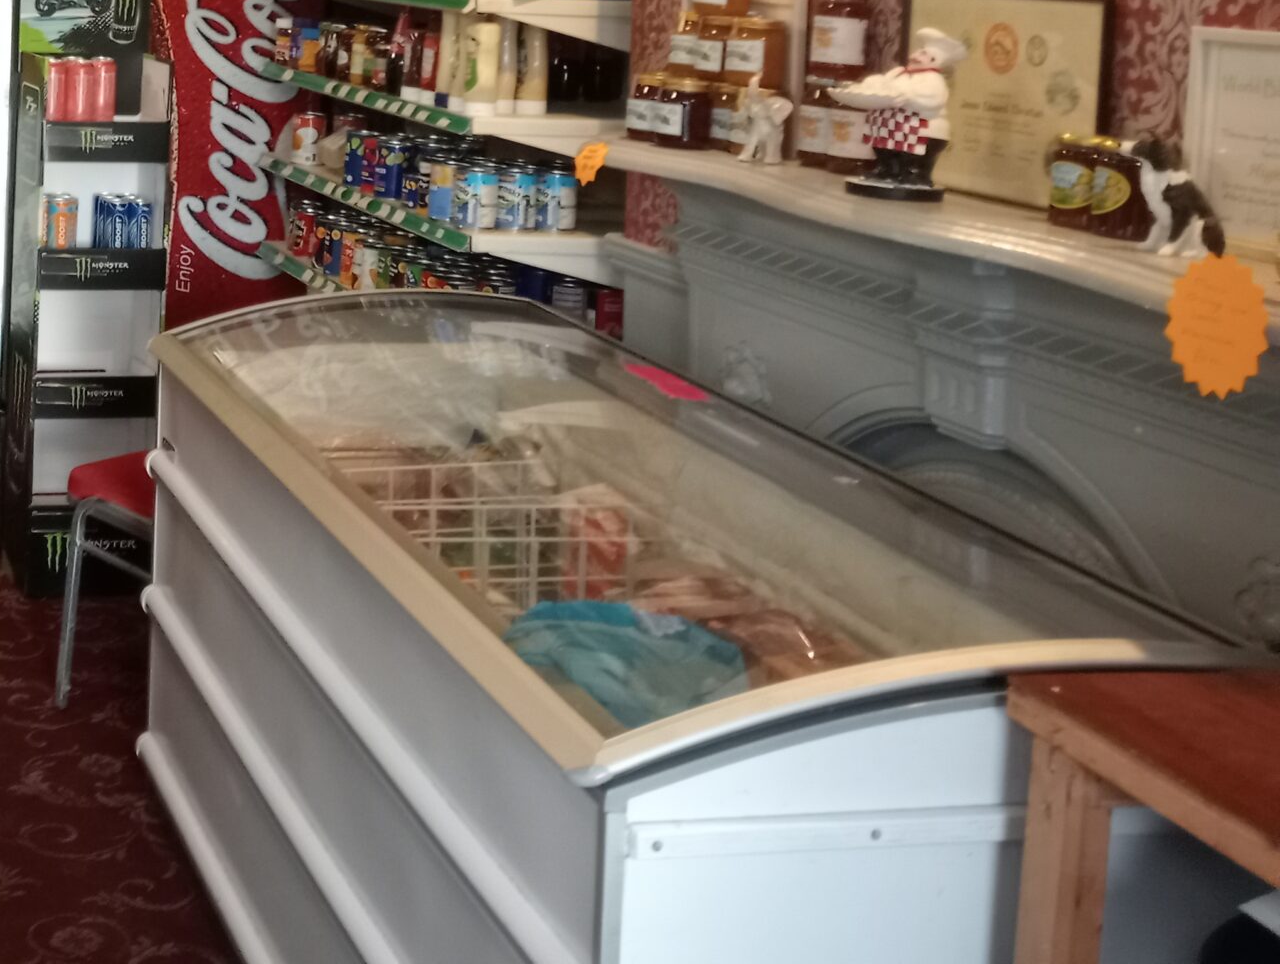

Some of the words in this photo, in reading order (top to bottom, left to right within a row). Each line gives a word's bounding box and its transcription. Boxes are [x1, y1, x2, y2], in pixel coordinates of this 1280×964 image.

[97, 134, 134, 142] MONSTER
[115, 218, 124, 248] BOOST
[140, 218, 149, 248] BOOST
[92, 261, 129, 269] MONSTER
[176, 244, 195, 293] Enjoy
[87, 389, 124, 397] MONSTER
